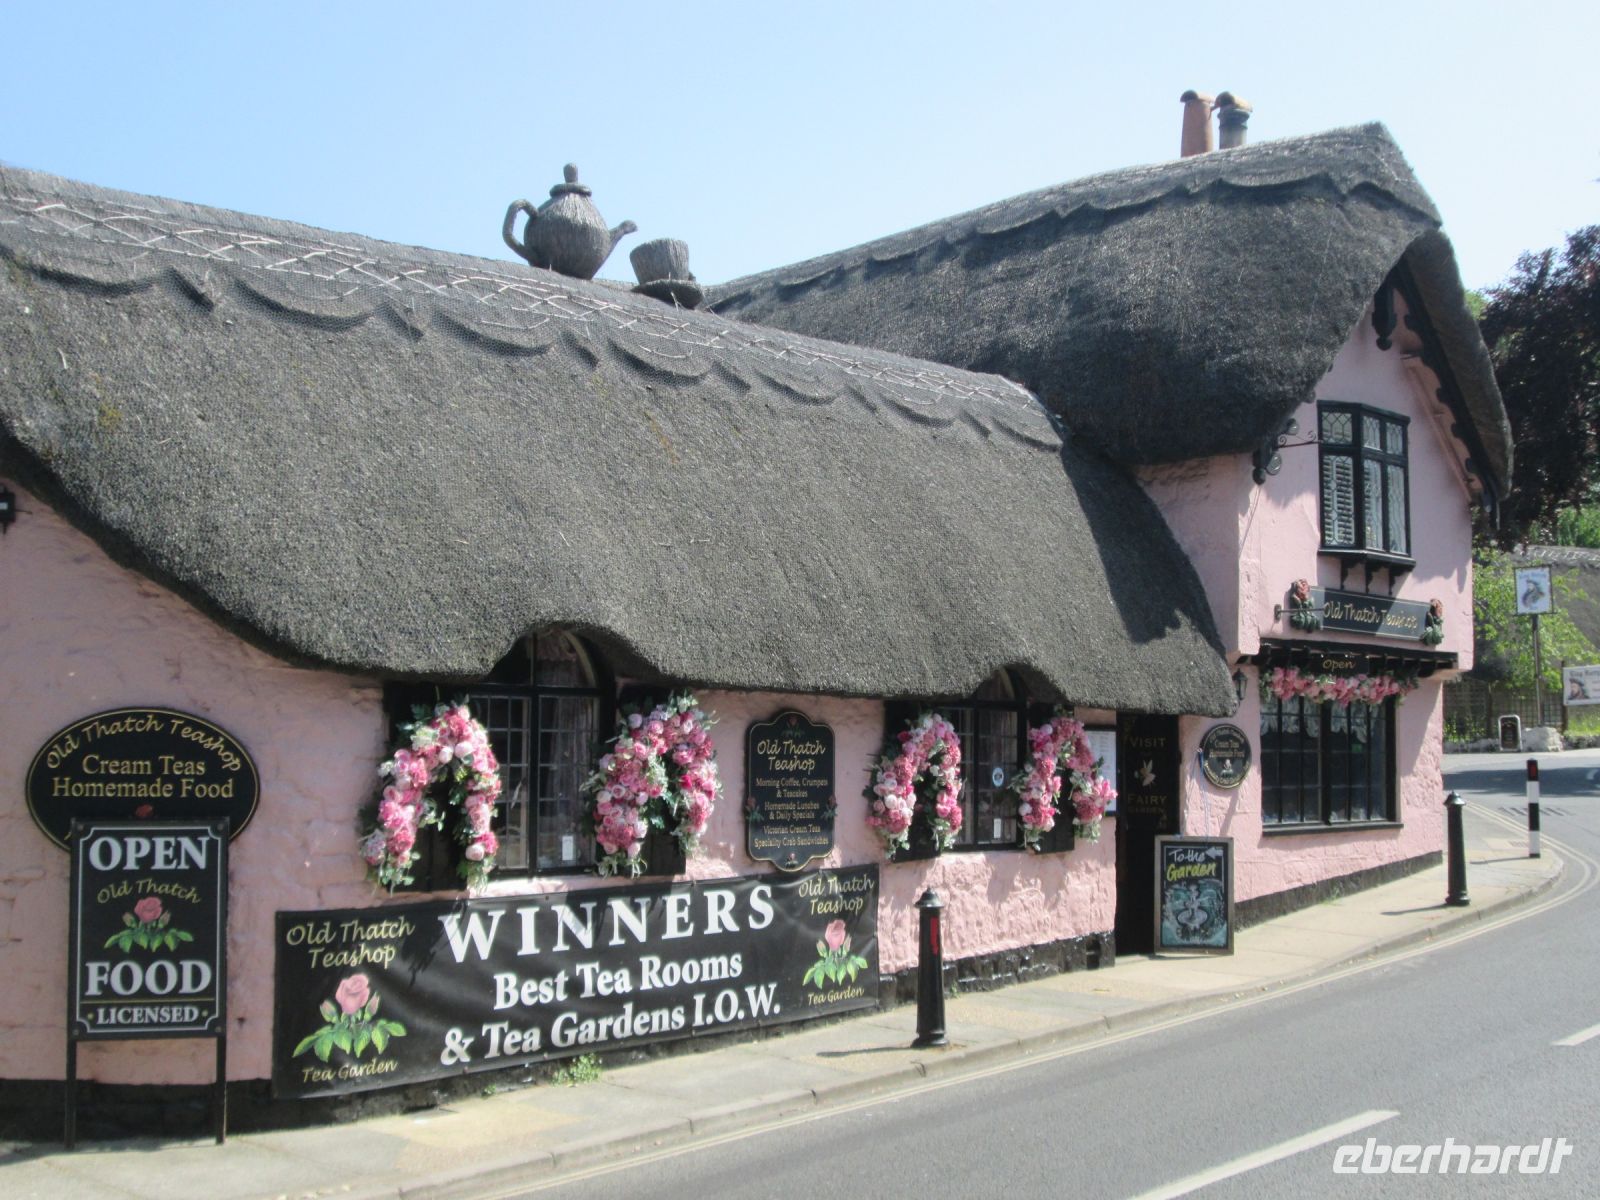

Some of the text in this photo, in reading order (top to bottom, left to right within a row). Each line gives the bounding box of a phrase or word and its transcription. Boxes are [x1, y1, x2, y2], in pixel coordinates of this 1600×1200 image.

[1323, 601, 1343, 619] Old
[1344, 604, 1380, 623] Thatch
[1322, 659, 1356, 672] Open
[47, 714, 241, 772] Old Thatch Teashop
[757, 739, 825, 755] Old Thatch
[1129, 737, 1167, 748] VISIT
[82, 754, 205, 775] Cream Teas
[768, 756, 815, 775] Teashop
[52, 777, 234, 798] Homemade Food
[776, 790, 782, 798] &
[764, 801, 796, 811] Homemade
[1128, 795, 1167, 806] FAIRY
[769, 811, 775, 820] &
[89, 836, 210, 871] OPEN
[1168, 849, 1206, 862] To the
[1166, 862, 1218, 881] Garden
[97, 879, 201, 904] Old Thatch
[799, 874, 874, 898] Old Thatch
[810, 895, 863, 915] Teashop
[286, 916, 416, 946] Old Thatch
[438, 885, 774, 963] WINNERS
[308, 943, 396, 969] Teashop
[85, 960, 212, 995] FOOD
[493, 953, 743, 1010] Best Tea Rooms
[808, 986, 864, 1006] Tea Garden
[97, 1006, 199, 1025] LICENSED
[440, 983, 781, 1066] & Tea Gardens I.O.W.
[302, 1058, 398, 1083] Tea Garden
